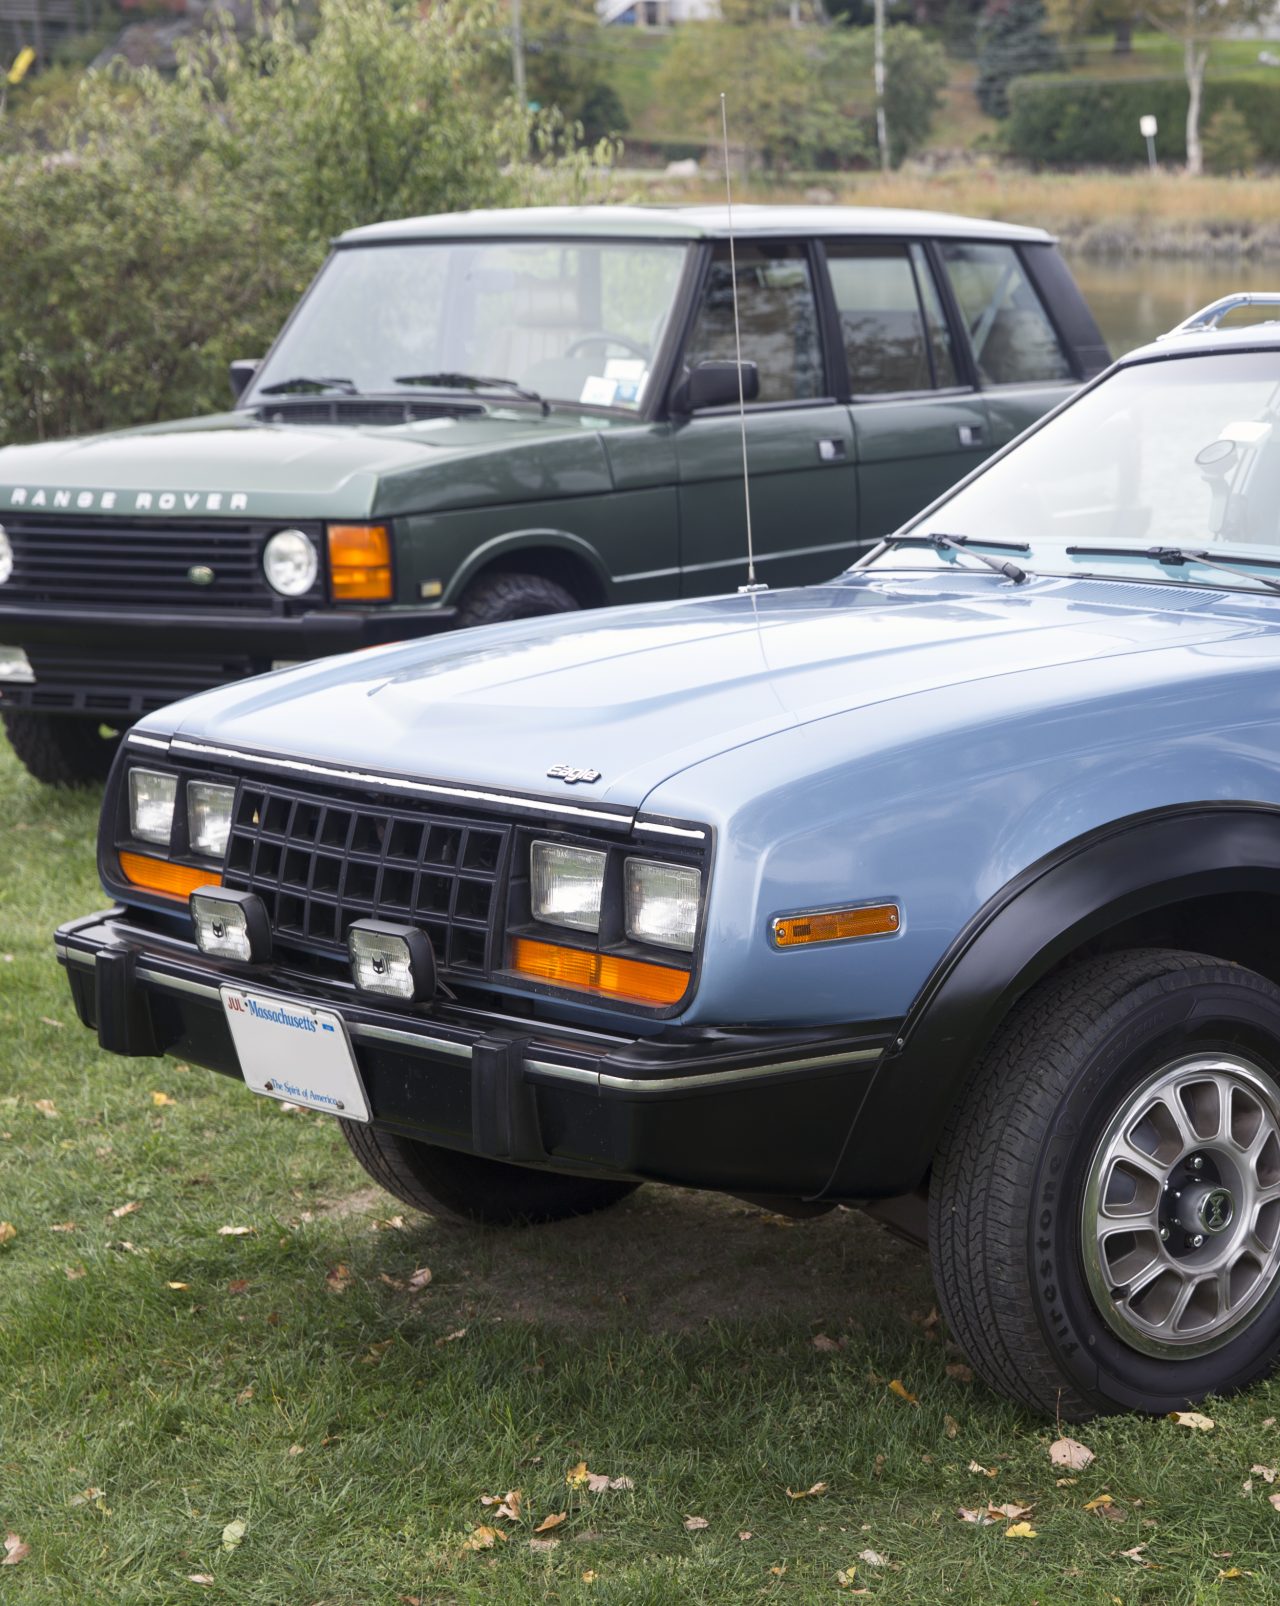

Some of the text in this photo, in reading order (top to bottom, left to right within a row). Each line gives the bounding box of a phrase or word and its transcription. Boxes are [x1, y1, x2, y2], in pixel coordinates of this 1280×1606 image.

[10, 487, 248, 510] RANGE ROVER
[547, 764, 601, 785] Eagle
[228, 997, 316, 1032] JUL Massachusetts
[271, 1078, 283, 1091] The
[283, 1080, 301, 1096] Spirit
[310, 1089, 338, 1106] America
